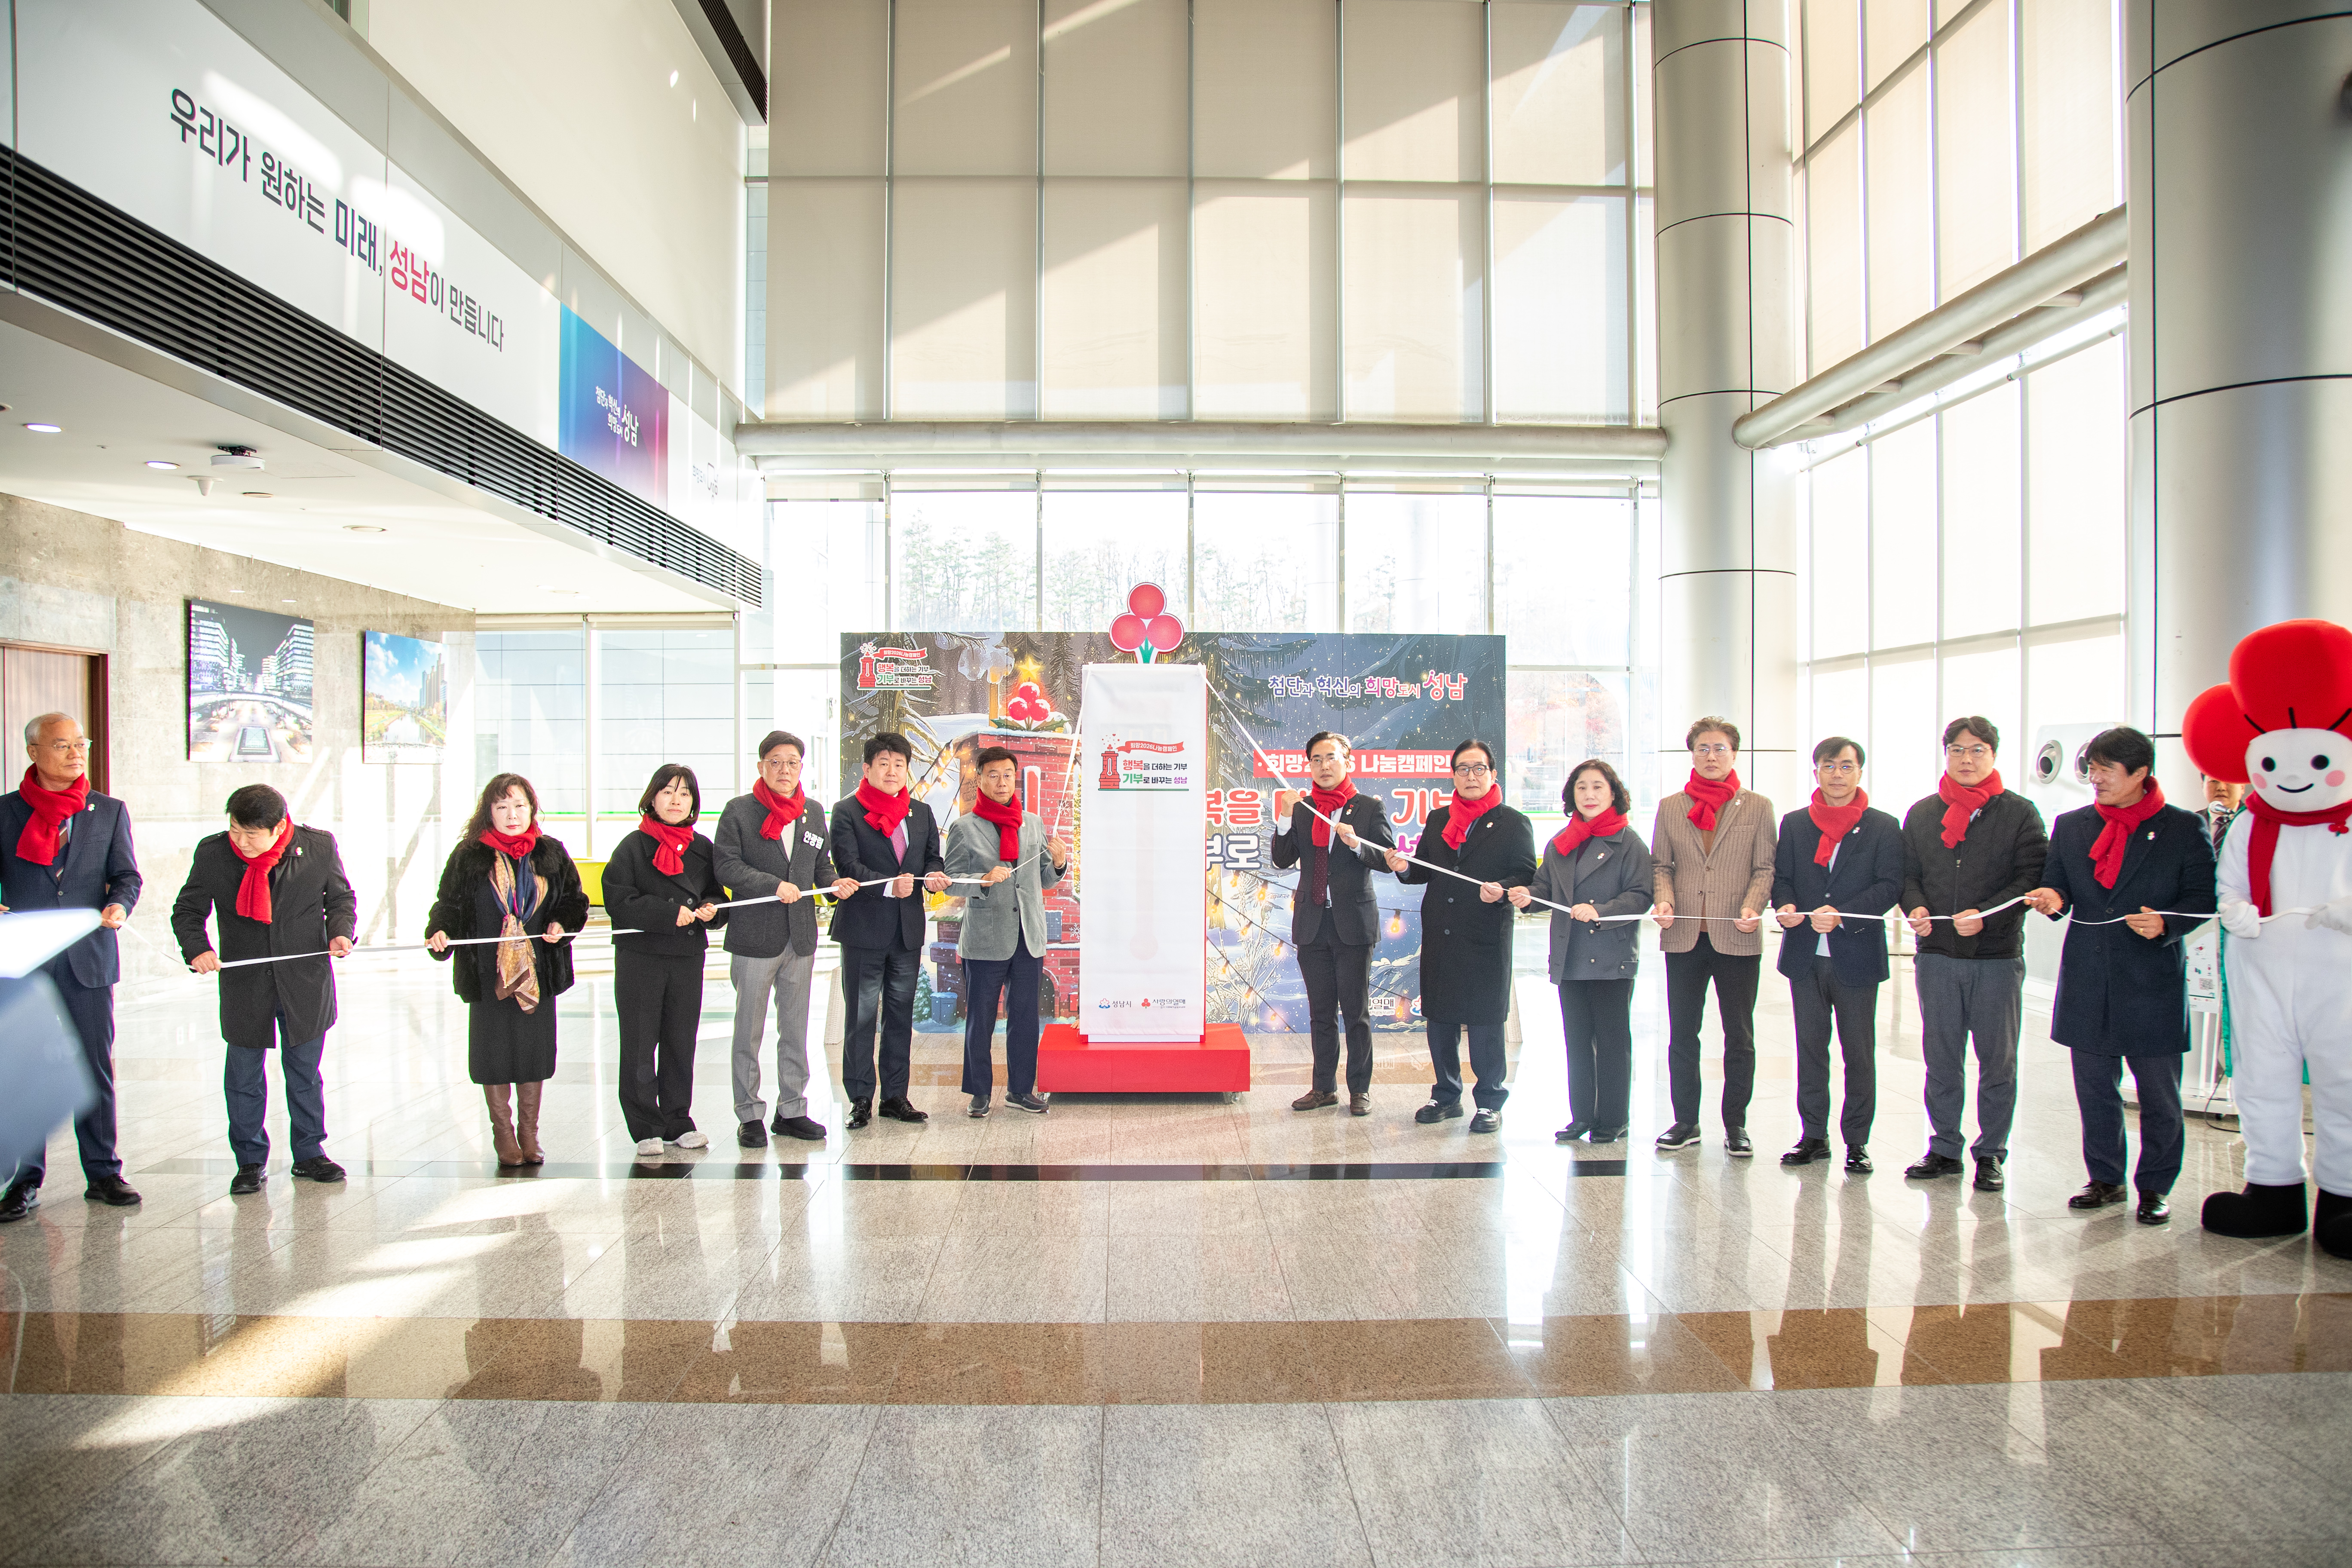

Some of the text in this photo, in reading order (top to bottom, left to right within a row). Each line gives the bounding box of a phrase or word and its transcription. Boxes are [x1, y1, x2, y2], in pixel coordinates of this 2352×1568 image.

[171, 89, 504, 352] 우리가 원하는 미래, 성남이 만듭니다
[596, 386, 621, 418] 첨단과 혁신의
[607, 404, 639, 447] 희망도시 성남
[878, 664, 899, 672] 행복을
[878, 675, 899, 683] 기부로
[1269, 670, 1468, 700] 첨단과 혁신의 희망도시 성남
[1123, 760, 1150, 770] 행복을
[1361, 754, 1451, 773] 나눔캠페인
[1123, 774, 1150, 784] 기부로
